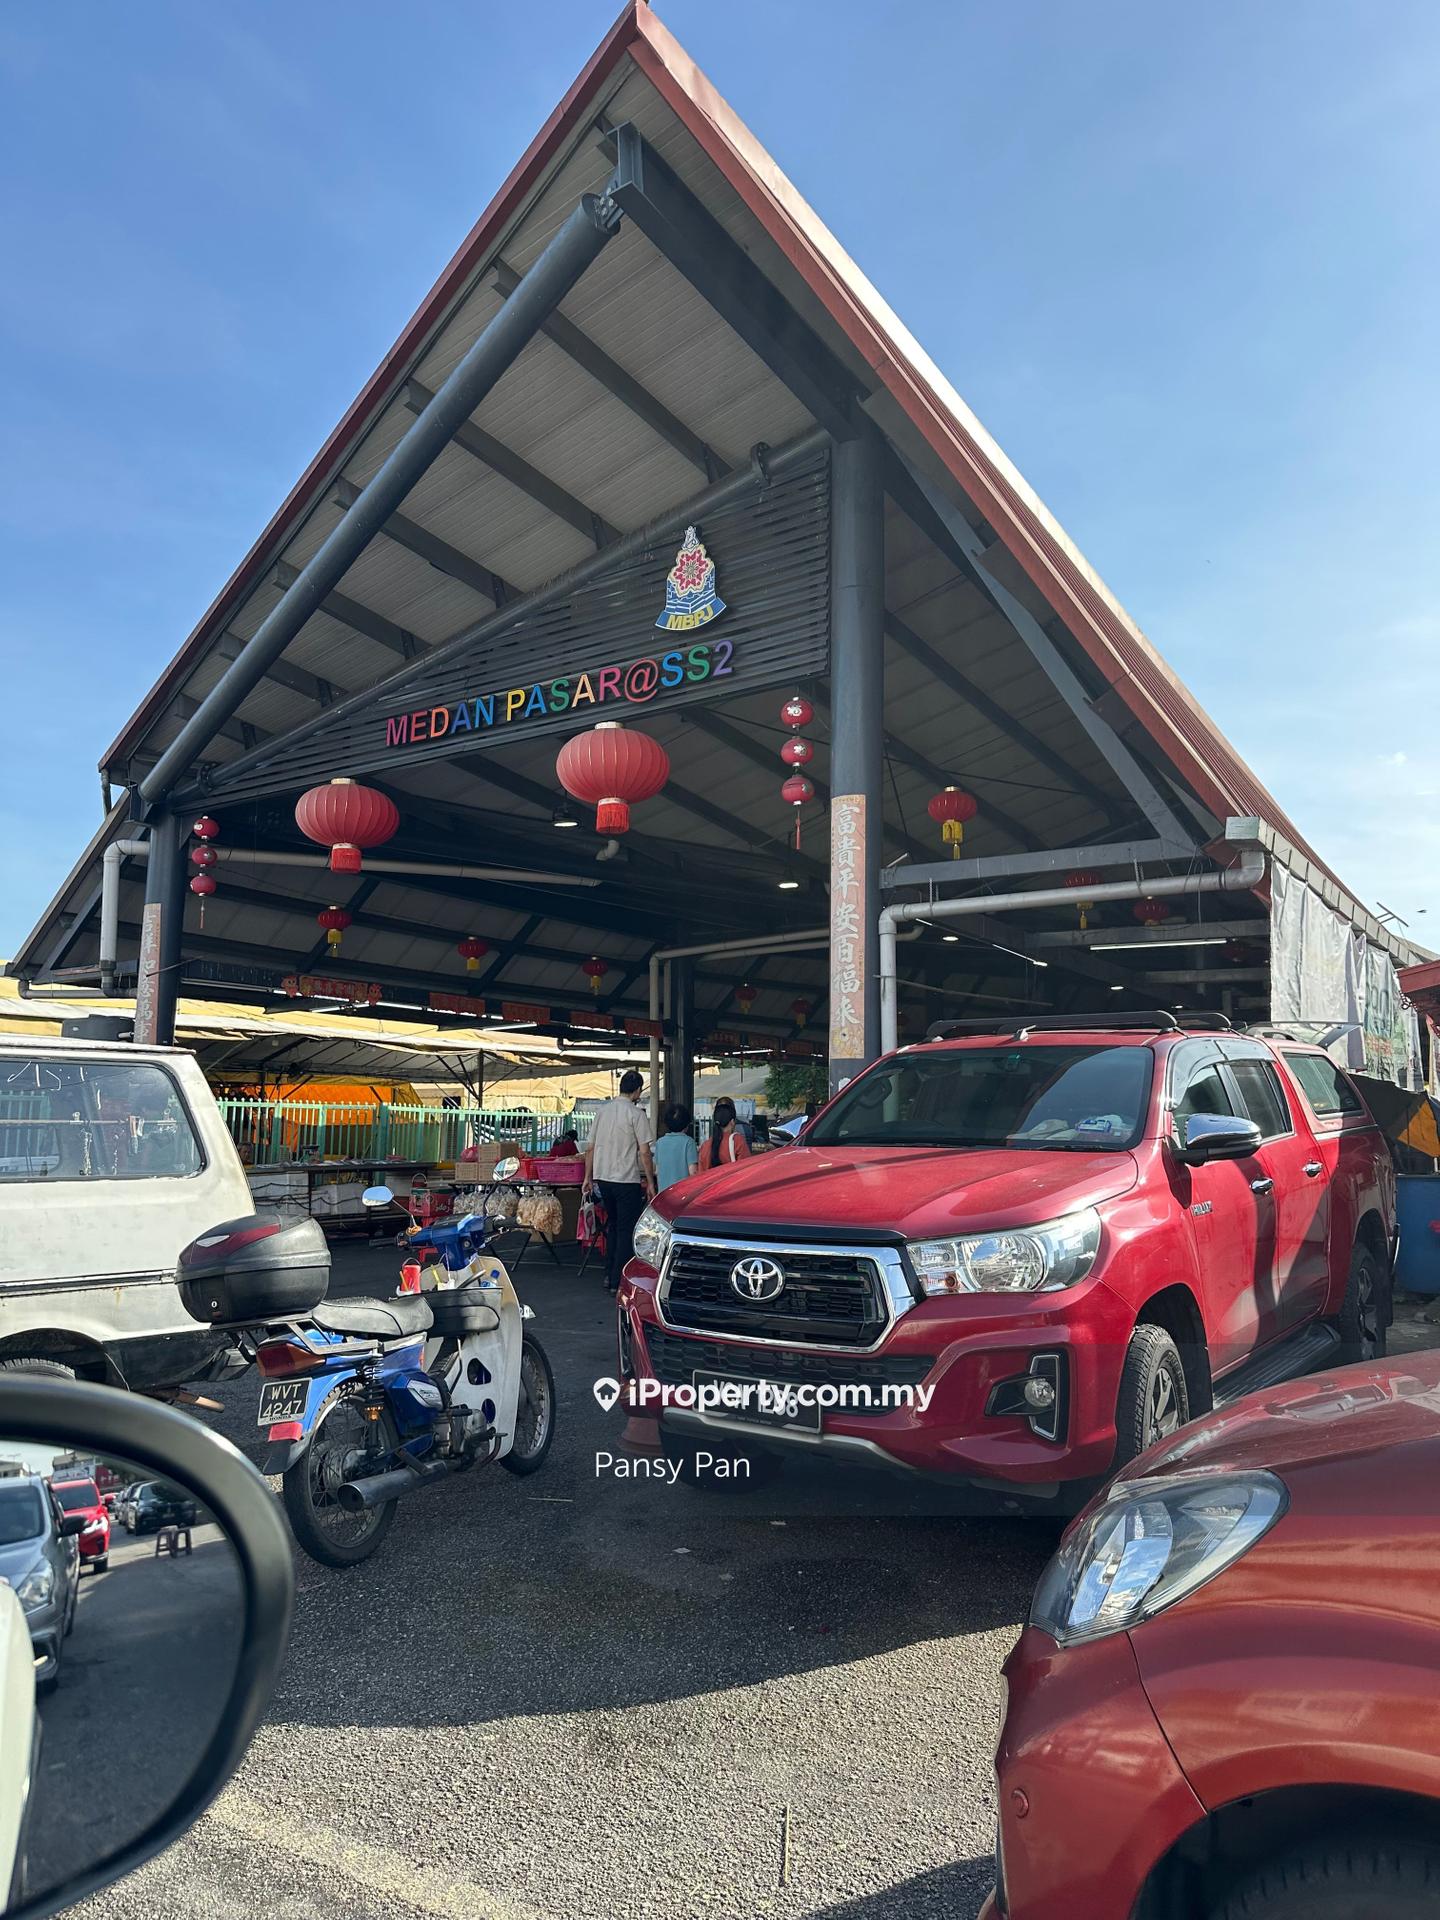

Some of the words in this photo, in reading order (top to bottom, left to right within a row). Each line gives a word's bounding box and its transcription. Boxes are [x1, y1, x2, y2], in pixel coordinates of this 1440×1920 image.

[666, 604, 714, 629] MBPJ
[385, 694, 495, 746] MEDAN
[505, 640, 734, 721] PASAR@SS2
[271, 1383, 302, 1400] WVT
[262, 1400, 302, 1417] 4247
